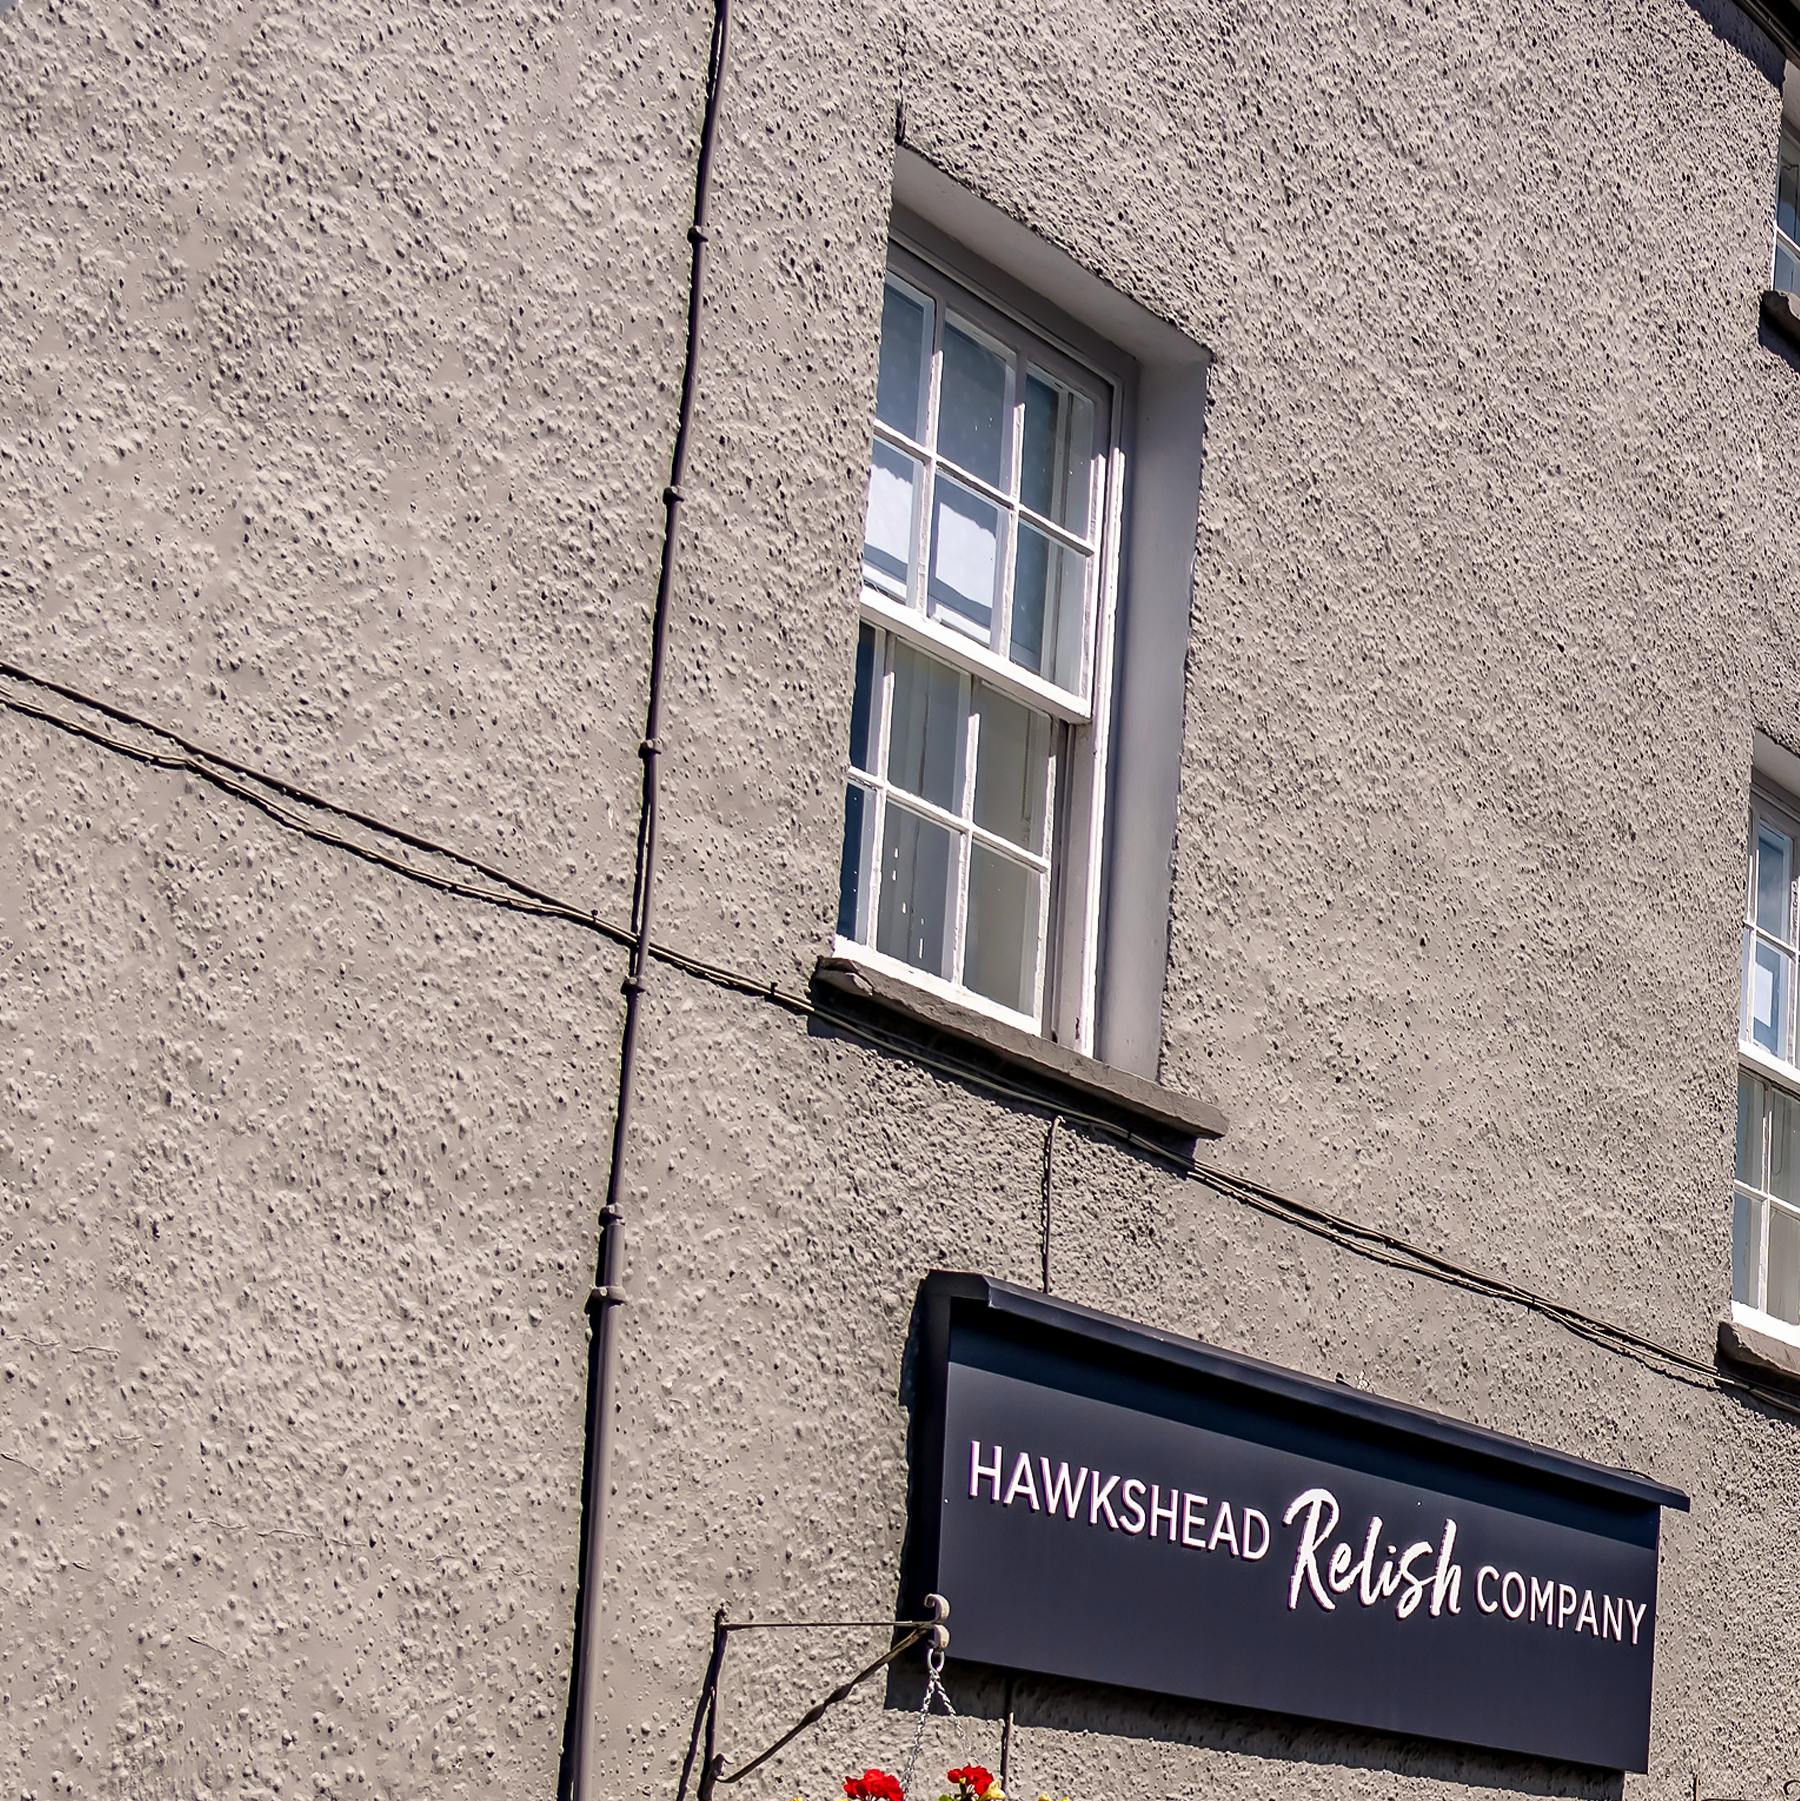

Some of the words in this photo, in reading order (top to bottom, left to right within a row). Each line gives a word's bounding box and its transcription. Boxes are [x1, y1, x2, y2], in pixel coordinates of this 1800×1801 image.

[968, 1440, 1271, 1561] HAWKSHEAD
[1282, 1487, 1461, 1620] Relish
[1473, 1563, 1648, 1646] COMPANY
